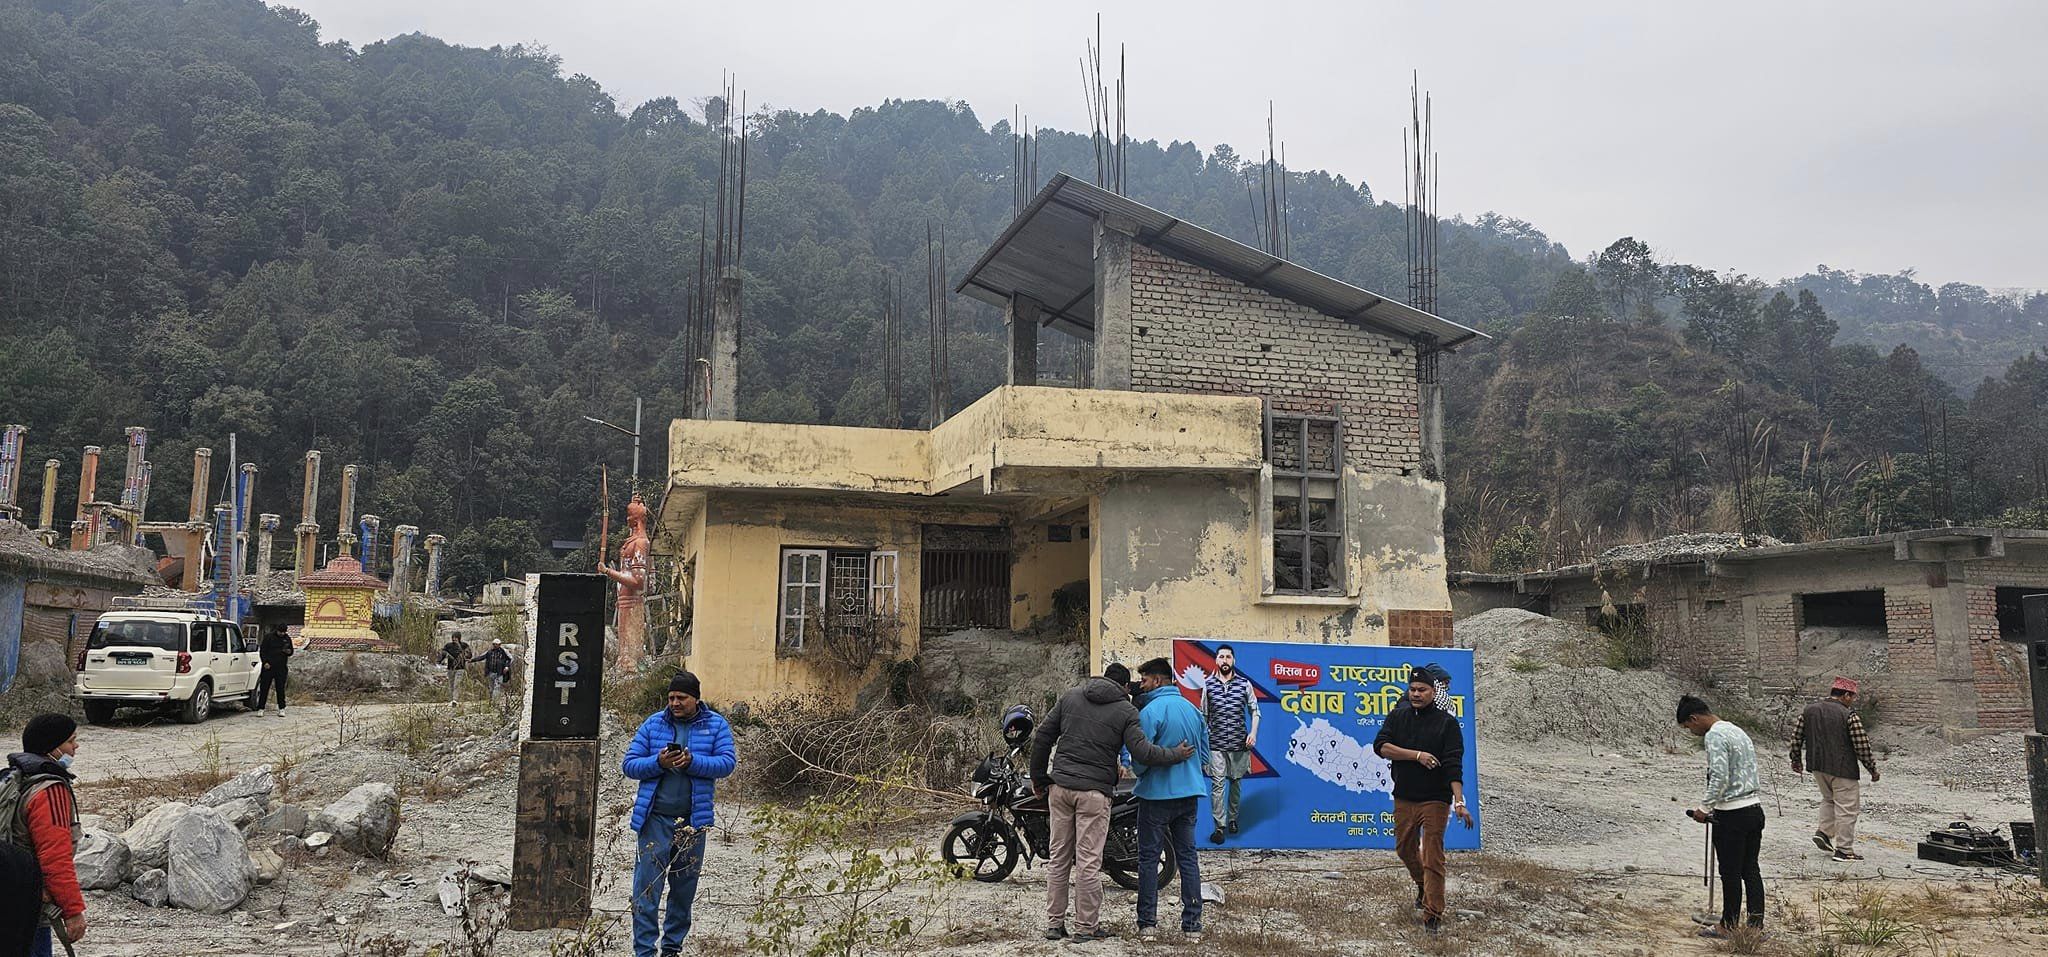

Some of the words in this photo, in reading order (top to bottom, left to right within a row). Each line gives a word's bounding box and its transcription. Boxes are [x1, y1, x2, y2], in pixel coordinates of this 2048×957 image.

[554, 622, 580, 705] RST
[1274, 663, 1302, 677] मिसन
[1305, 667, 1318, 678] ८०
[1329, 662, 1414, 687] राष्ट्रव्यापी
[1280, 689, 1346, 715] दबाब
